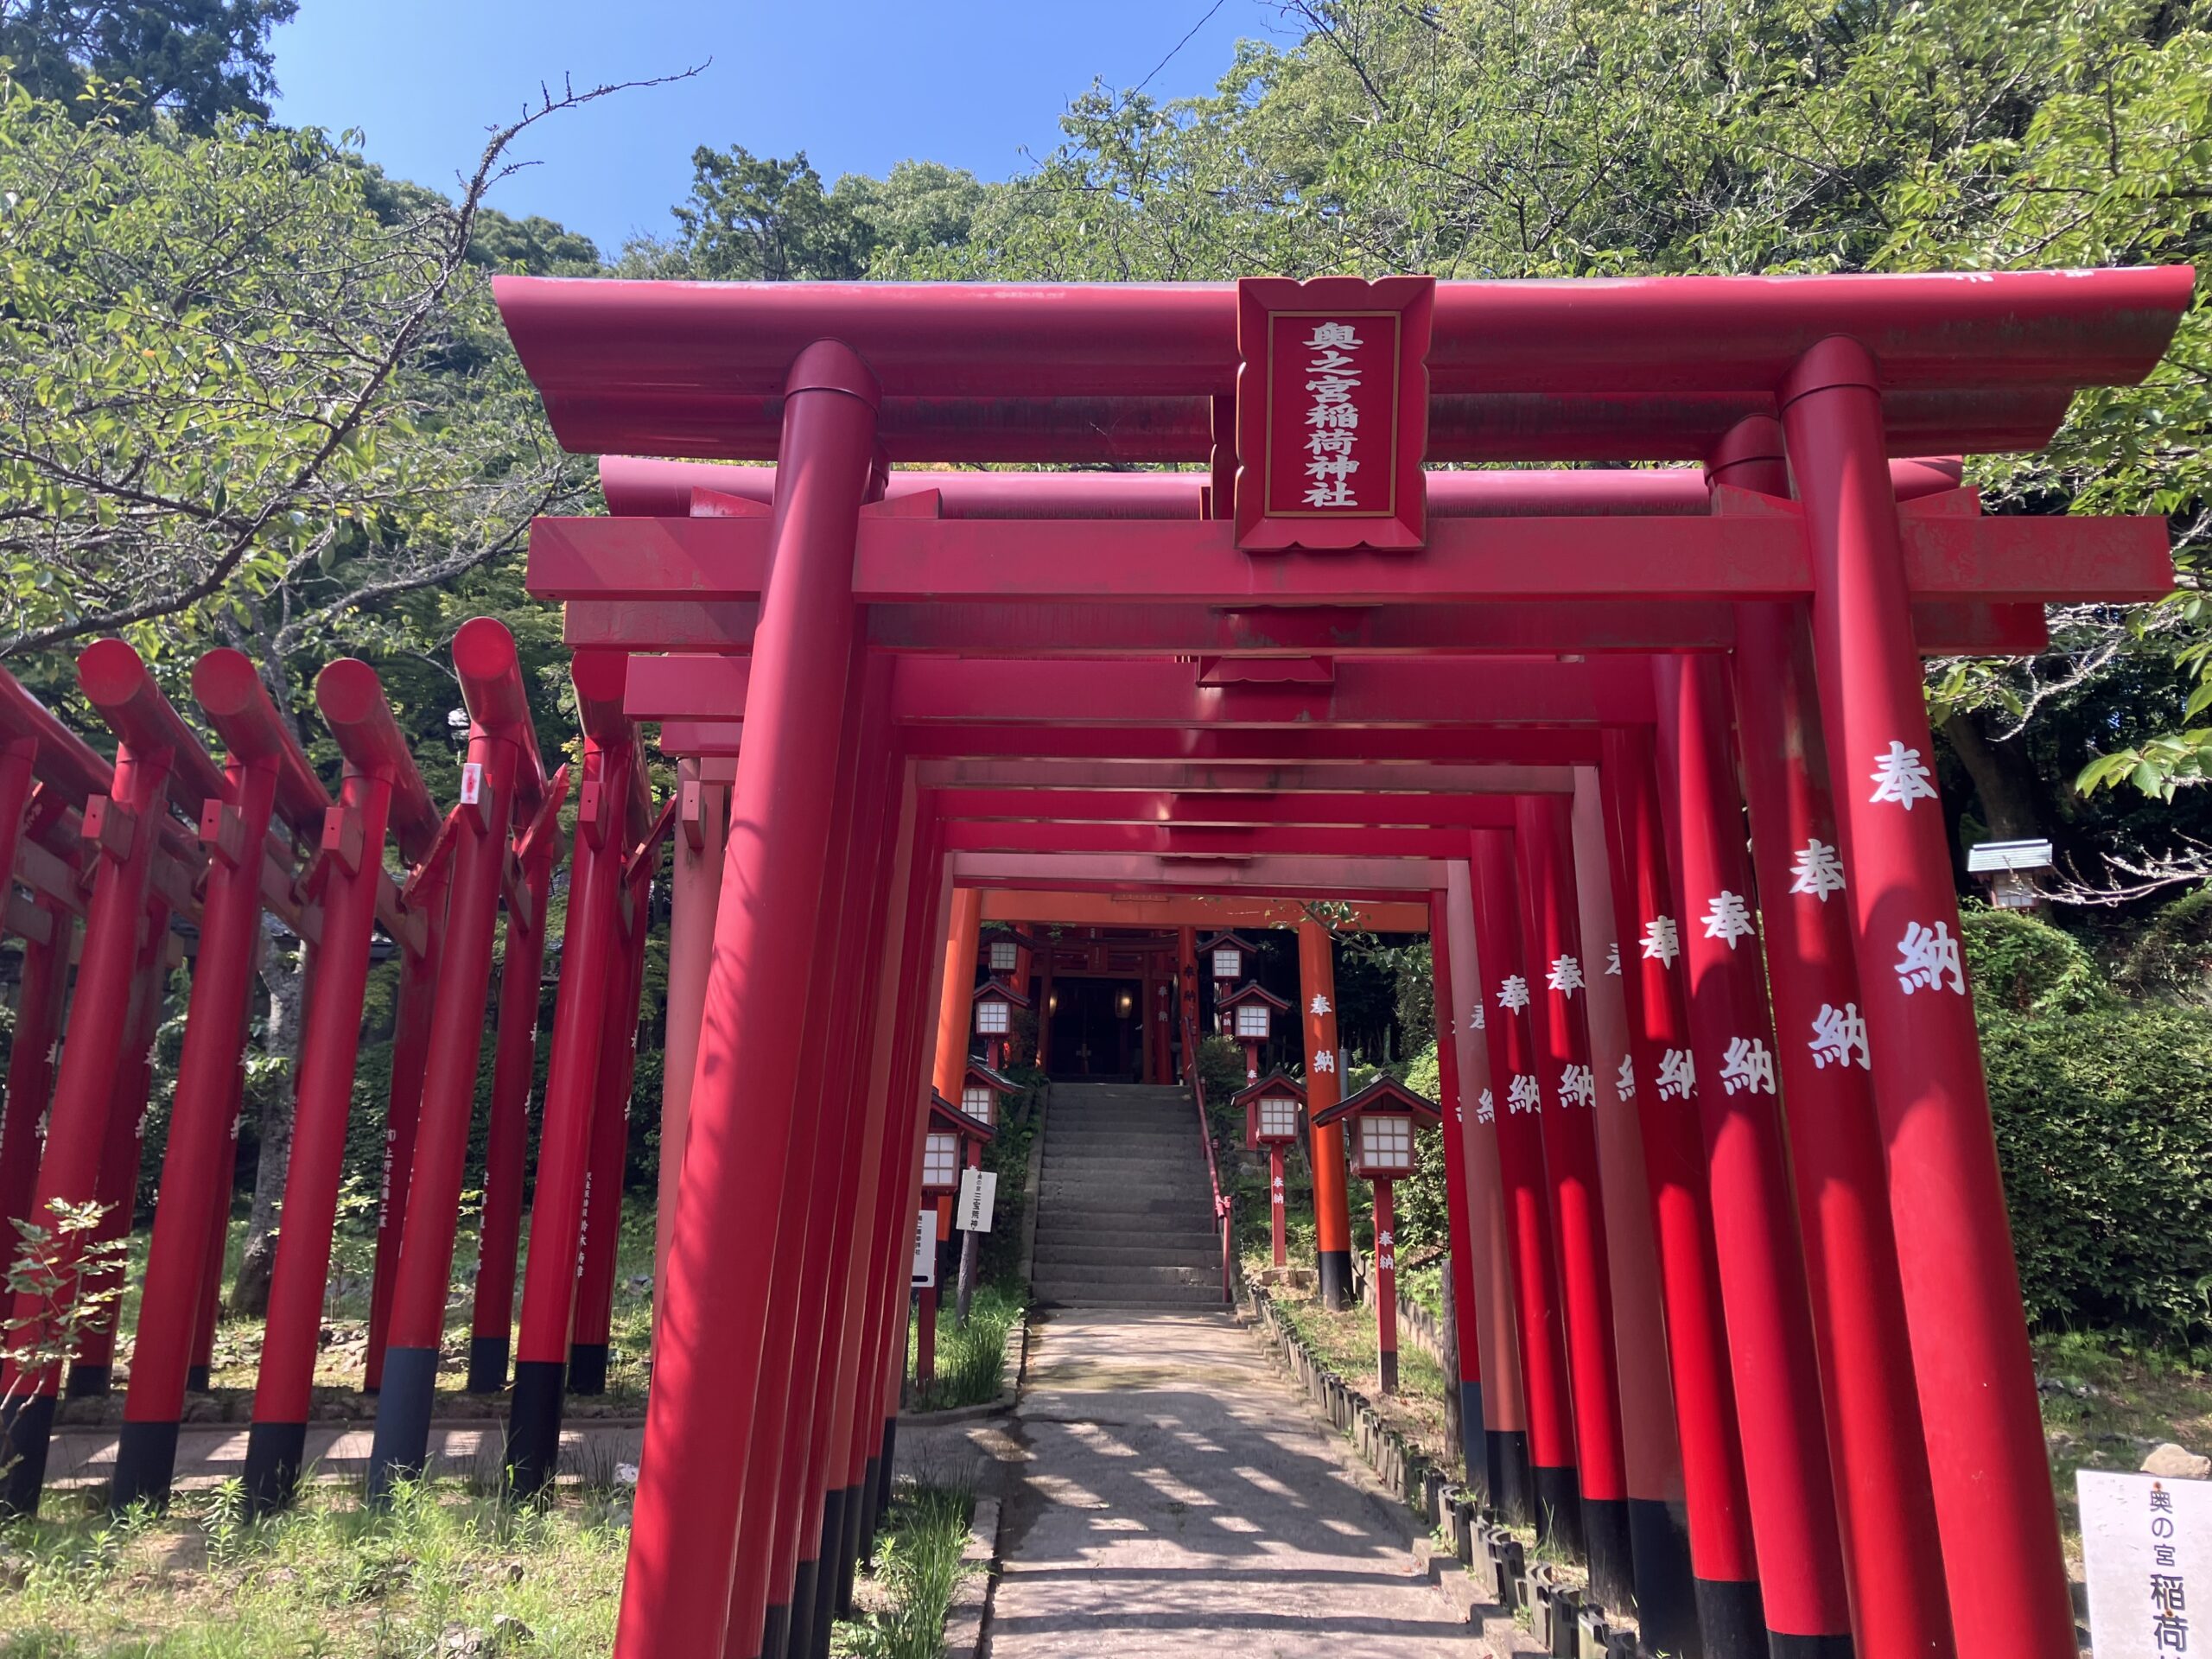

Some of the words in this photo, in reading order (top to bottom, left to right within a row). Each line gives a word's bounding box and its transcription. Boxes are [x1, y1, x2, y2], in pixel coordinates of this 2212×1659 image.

[1869, 741, 1965, 995] 奉納
[1310, 994, 1335, 1073] 奉納
[1545, 954, 1597, 1108] 奉納
[1638, 915, 1698, 1102] 奉納
[1700, 891, 1776, 1096] 奉納
[1789, 838, 1871, 1071] 奉納
[1497, 975, 1541, 1114] 奉納
[1273, 1176, 1284, 1204] 奉納
[1378, 1230, 1395, 1270] 奉納
[2150, 1490, 2189, 1659] 奥の宮稲荷
